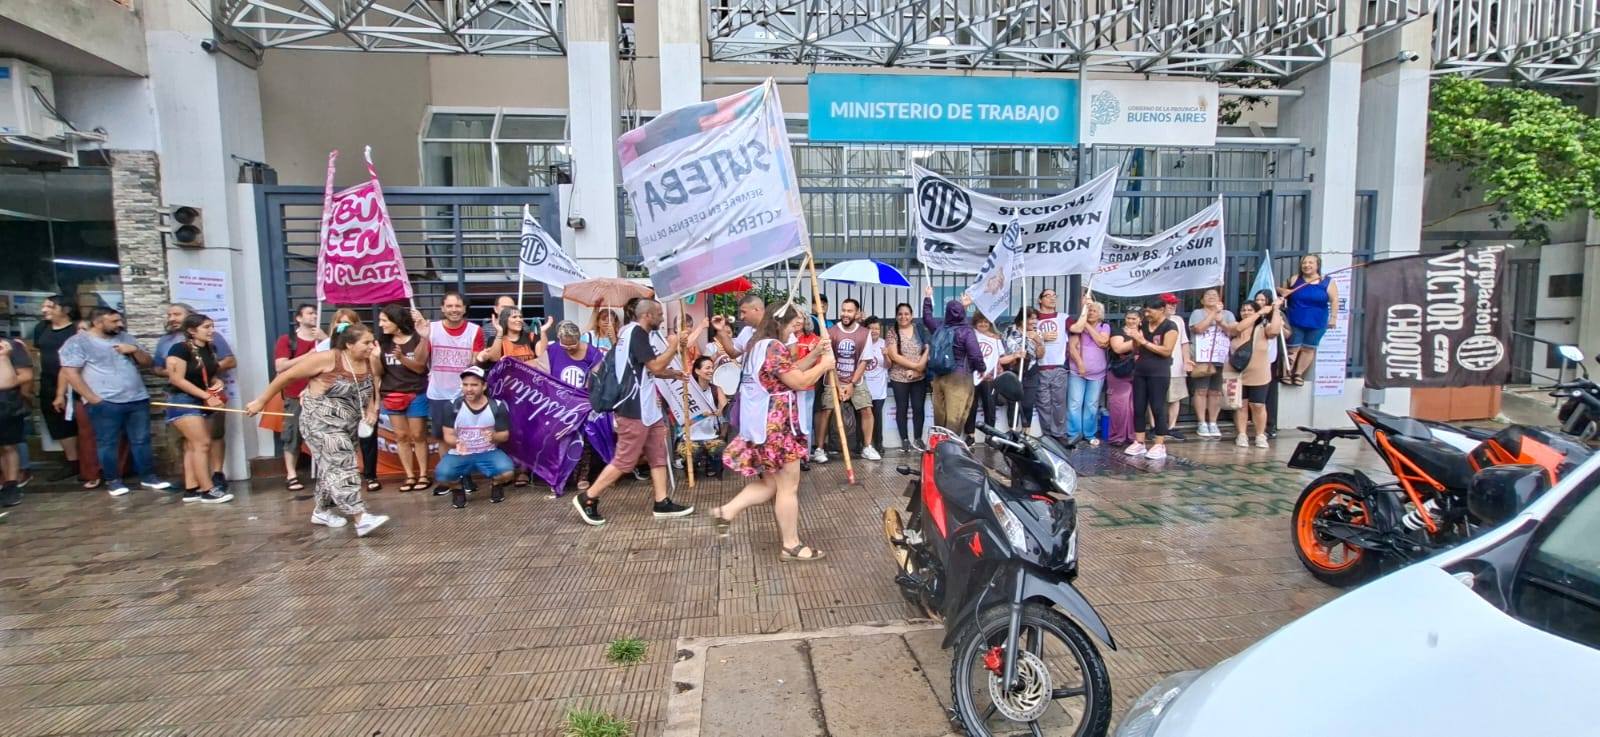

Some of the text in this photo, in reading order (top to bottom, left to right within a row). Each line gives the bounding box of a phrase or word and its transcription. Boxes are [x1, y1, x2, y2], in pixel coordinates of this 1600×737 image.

[830, 101, 1060, 124] MINISTERIO DE TRABAJO
[1127, 112, 1207, 123] BUENOS AIRES
[918, 176, 971, 232] ATE
[1034, 210, 1102, 236] BROWN
[1024, 236, 1092, 254] PERÓN
[1109, 251, 1139, 263] GRAN
[1142, 249, 1161, 260] BS.
[1186, 237, 1214, 250] SUR
[1173, 256, 1219, 269] ZAMORA
[1381, 303, 1424, 381] CHOQUE
[1457, 335, 1504, 371] ATE
[561, 366, 585, 387] ATE
